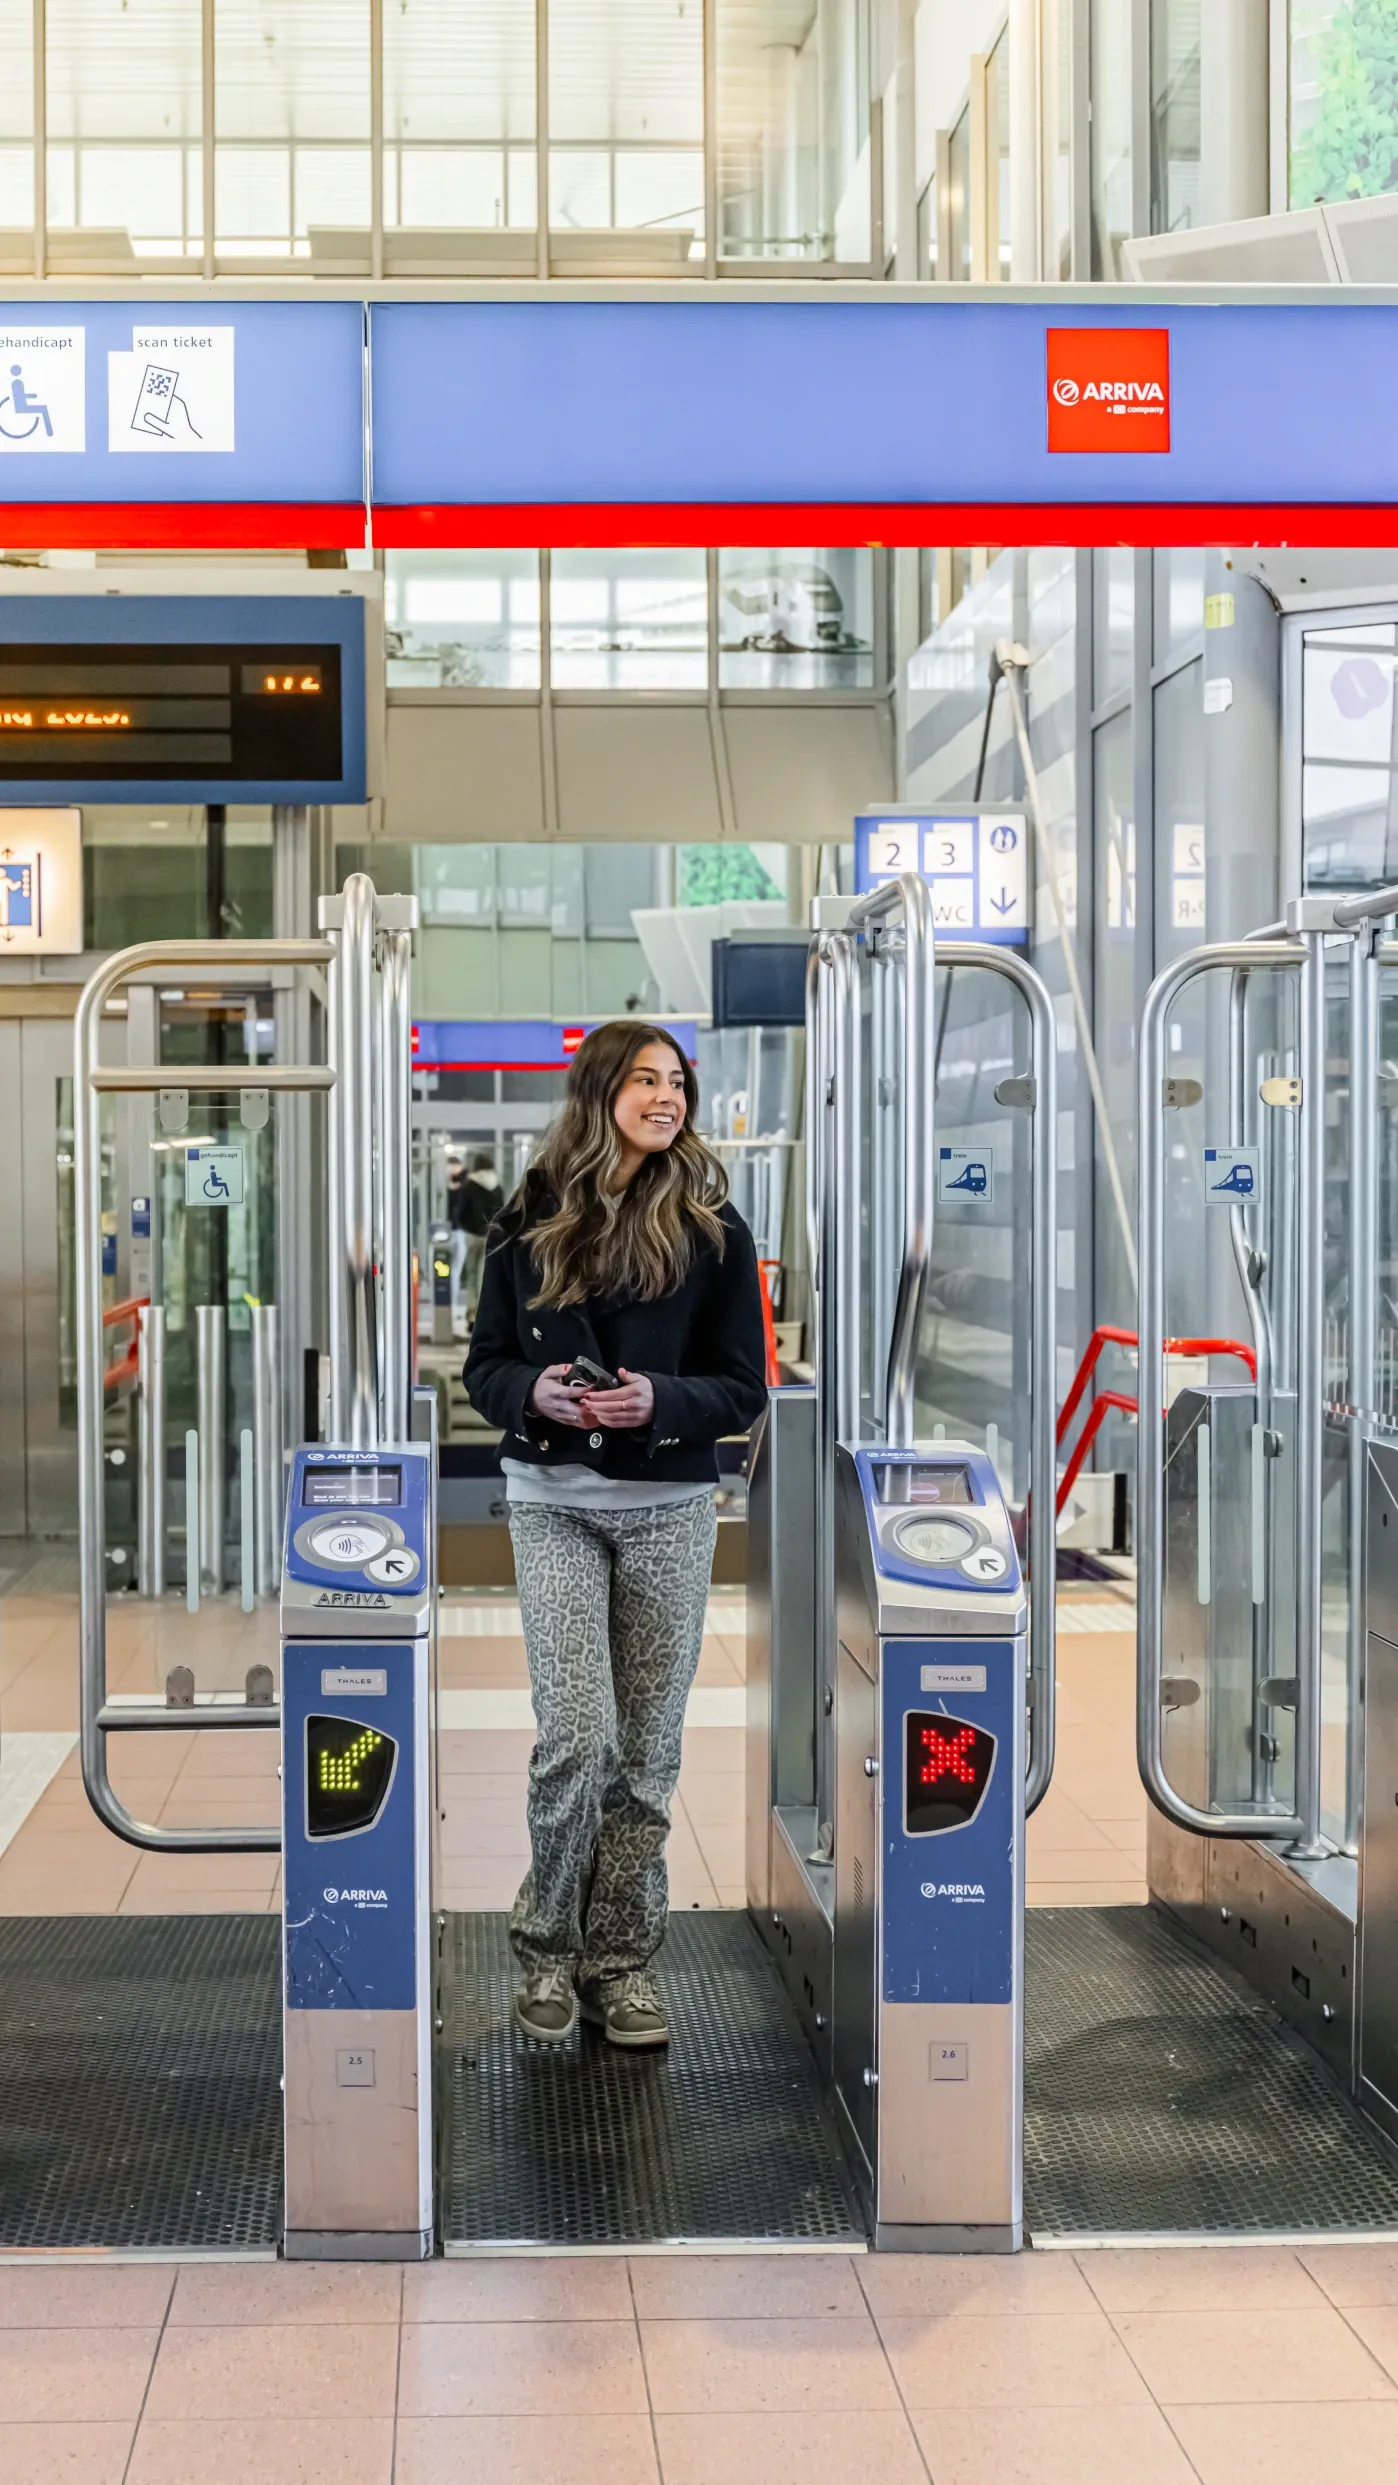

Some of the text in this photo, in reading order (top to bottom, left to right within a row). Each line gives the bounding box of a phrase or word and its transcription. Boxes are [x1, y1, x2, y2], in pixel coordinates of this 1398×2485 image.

[137, 336, 213, 348] scan ticket
[1082, 382, 1165, 401] ARRIVA
[1127, 406, 1165, 415] company
[886, 842, 901, 867] 2
[941, 842, 956, 867] 3
[933, 906, 969, 922] WC
[318, 1593, 386, 1606] ARRIVA
[340, 1889, 388, 1901] ARRIVA
[937, 1884, 985, 1896] ARRIVA
[942, 2050, 956, 2058] 2.6
[348, 2056, 363, 2065] 2.5
